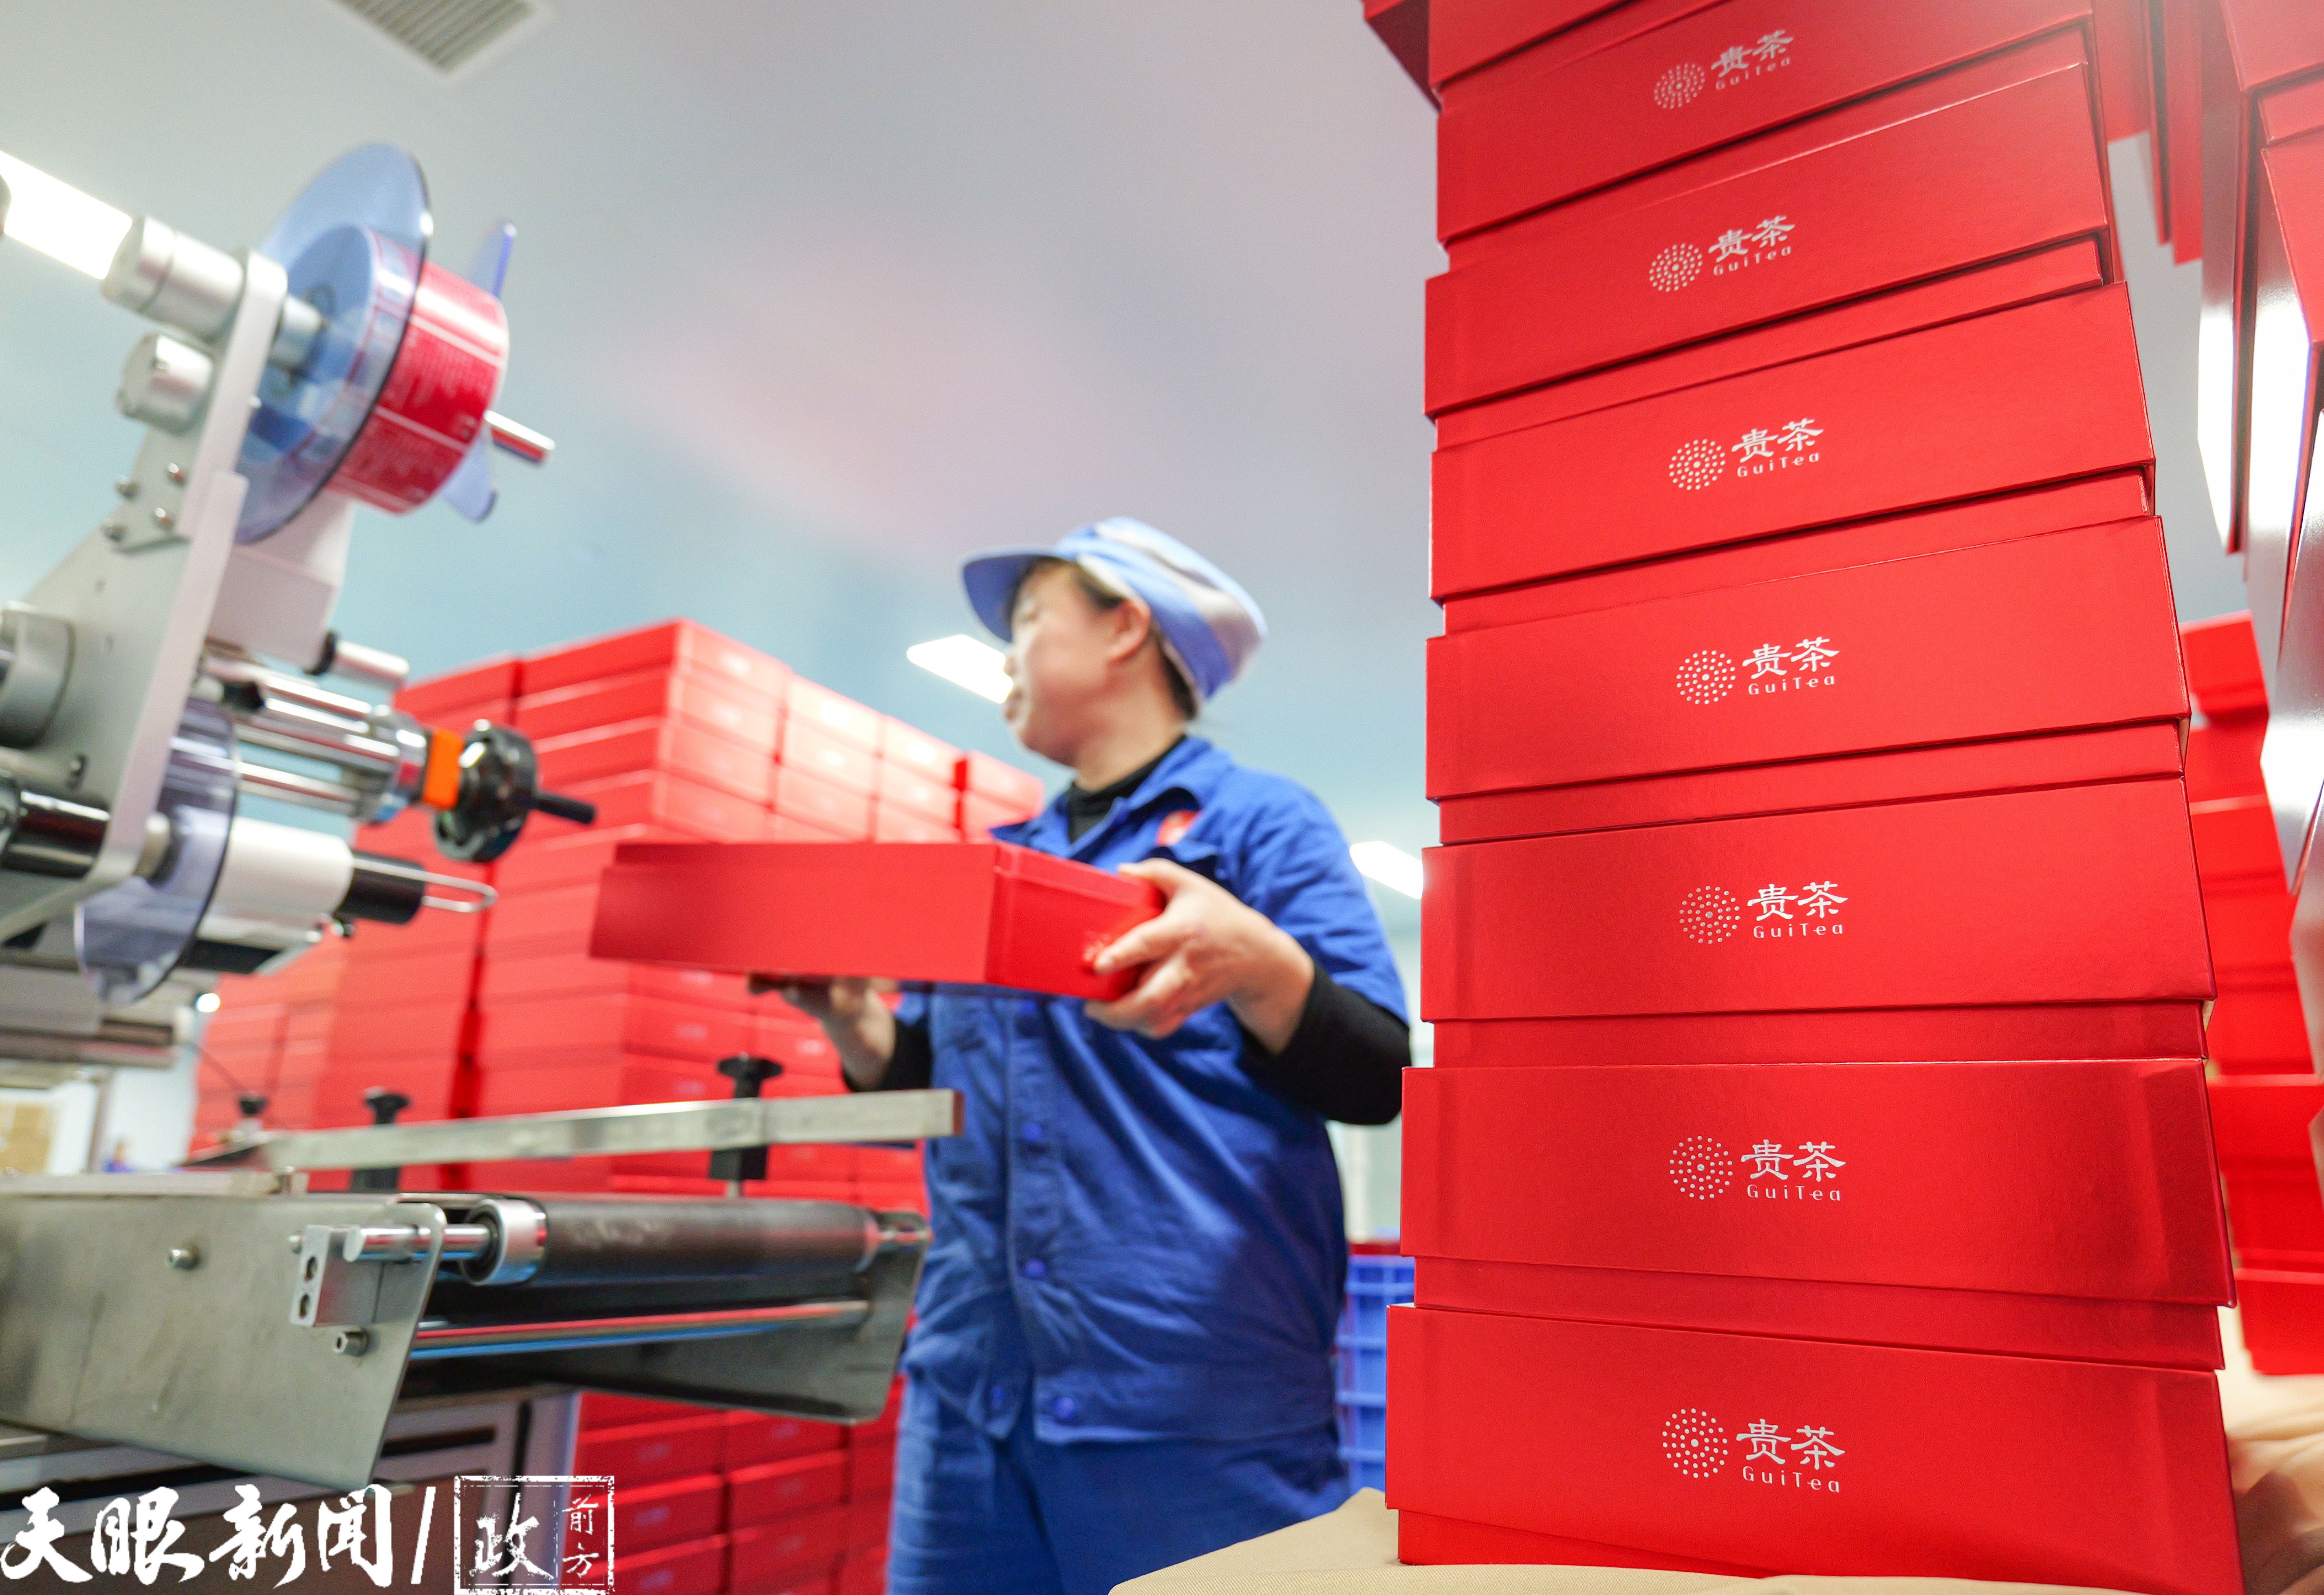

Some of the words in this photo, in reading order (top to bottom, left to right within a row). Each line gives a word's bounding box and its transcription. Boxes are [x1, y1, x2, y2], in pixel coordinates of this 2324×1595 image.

[1711, 30, 1794, 78] 贵茶
[1708, 215, 1795, 263] 贵茶
[1713, 246, 1792, 276] GuiTea
[1731, 418, 1824, 463] 贵茶
[1737, 452, 1820, 478] GuiTea
[1742, 636, 1840, 680] 贵茶
[1748, 676, 1835, 695] GuiTea
[1747, 880, 1849, 922] 贵茶
[1753, 923, 1844, 938] GuiTea
[1740, 1139, 1846, 1183] 贵茶
[1747, 1184, 1841, 1201] GuiTea
[1736, 1418, 1846, 1471] 贵茶
[1742, 1465, 1840, 1493] GuiTea
